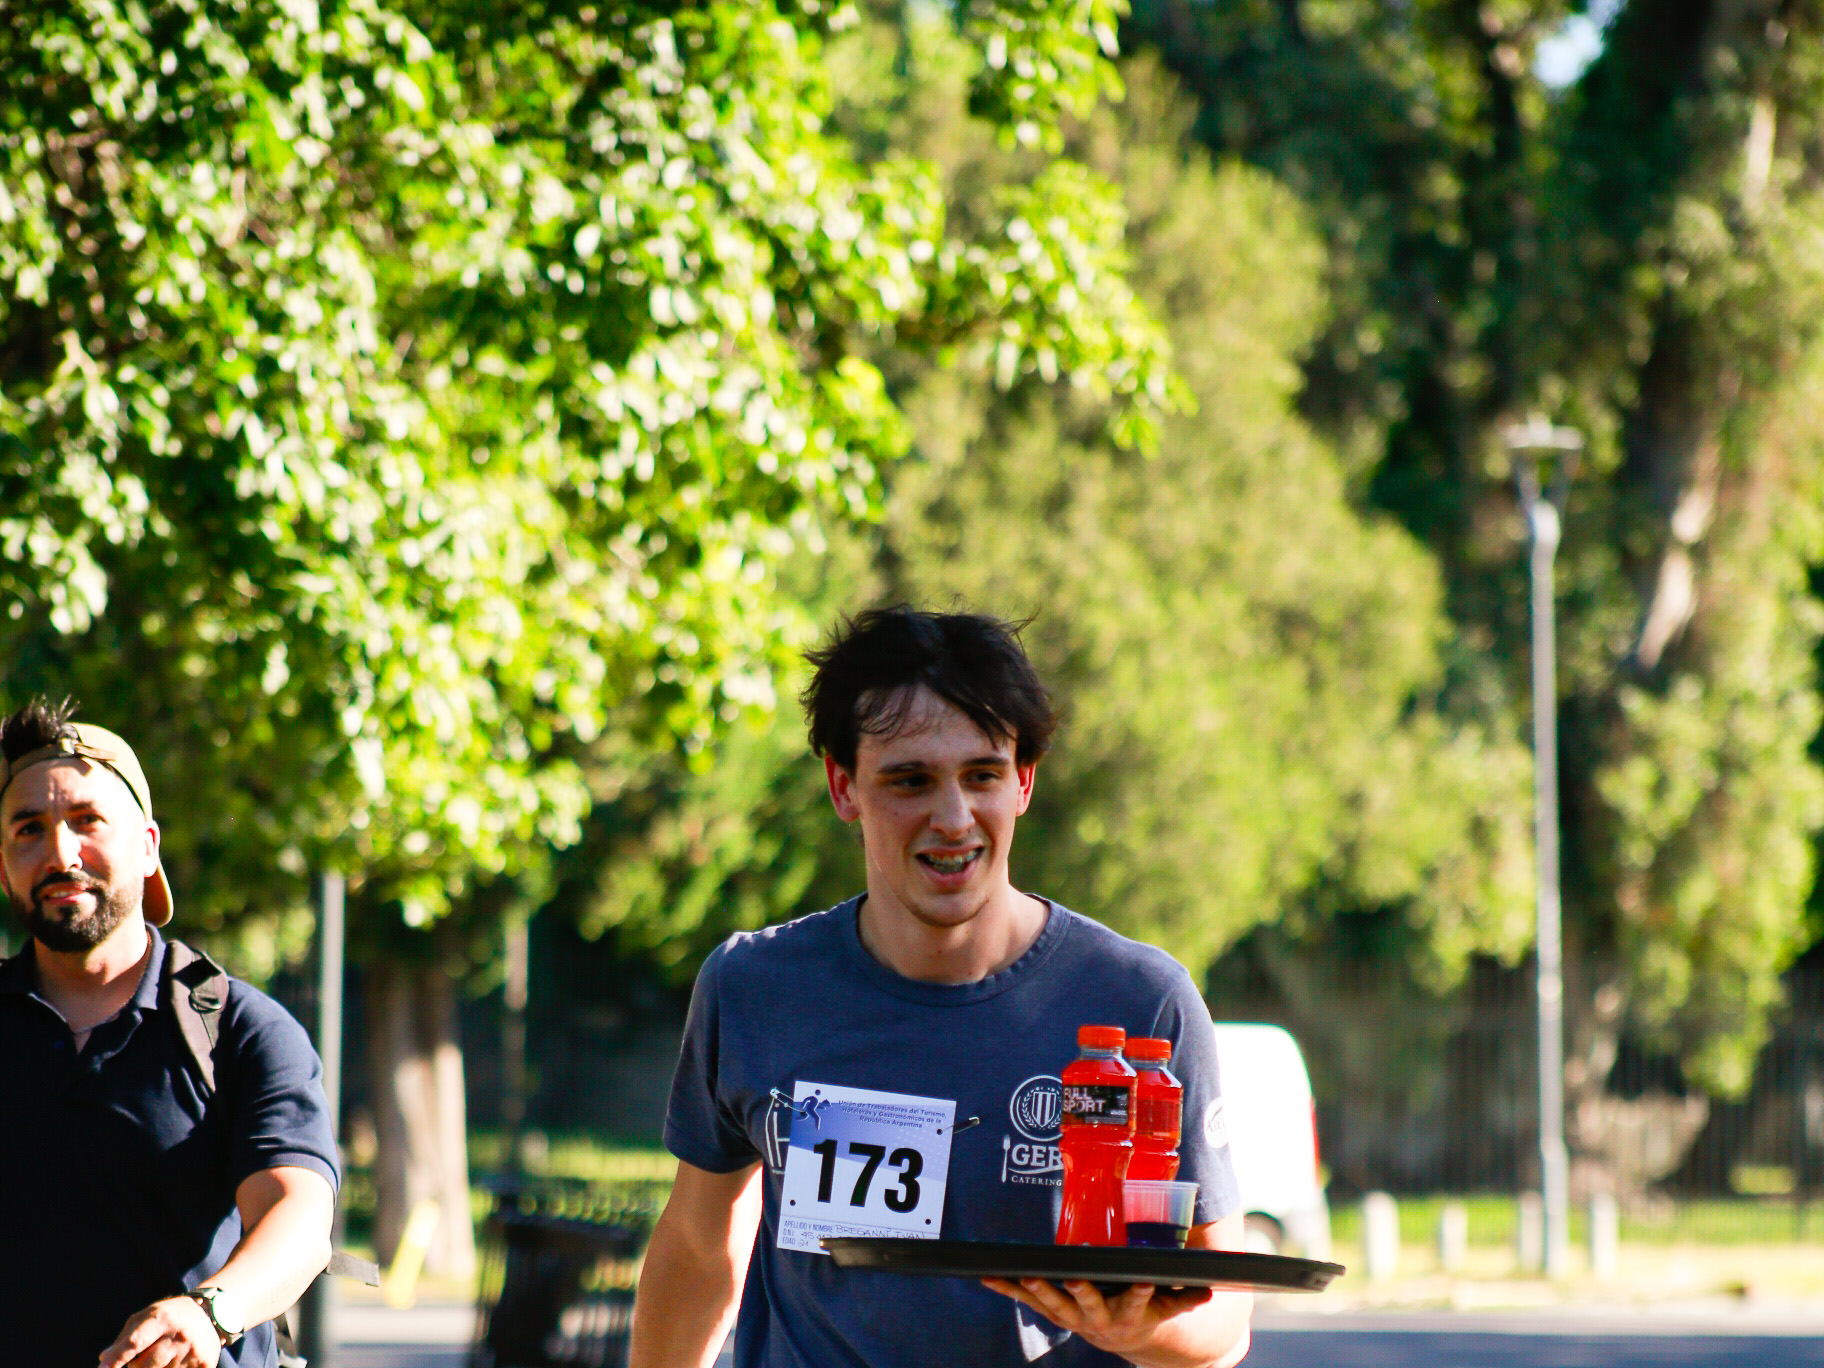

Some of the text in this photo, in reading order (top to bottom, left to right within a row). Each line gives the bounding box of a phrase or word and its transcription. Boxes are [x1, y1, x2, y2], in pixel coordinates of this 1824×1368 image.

[868, 1103, 908, 1113] Trabajadores
[1063, 1099, 1106, 1113] SPORT
[842, 1107, 872, 1116] Hoteleros
[878, 1111, 925, 1122] Gastronómicos
[892, 1119, 923, 1129] Argentina
[813, 1138, 924, 1214] 173
[1011, 1175, 1062, 1187] CATERING
[784, 1220, 808, 1230] APELLIDO
[812, 1223, 833, 1233] NOMBRE
[782, 1236, 796, 1245] EDAD
